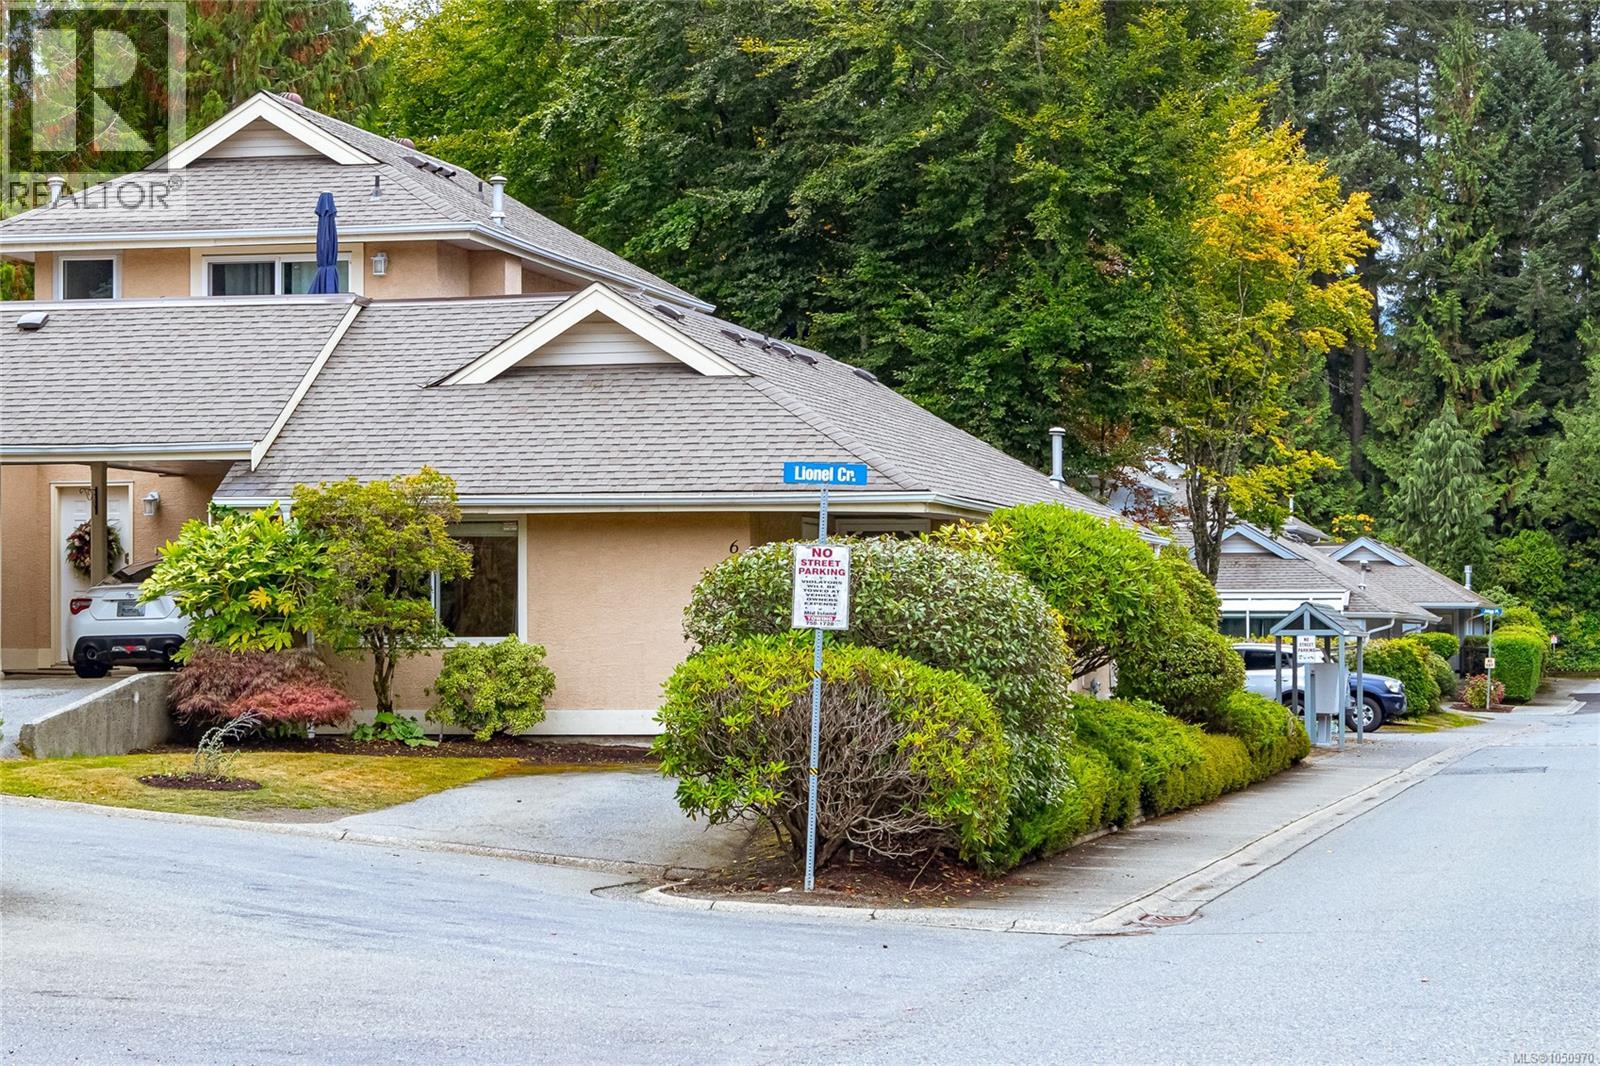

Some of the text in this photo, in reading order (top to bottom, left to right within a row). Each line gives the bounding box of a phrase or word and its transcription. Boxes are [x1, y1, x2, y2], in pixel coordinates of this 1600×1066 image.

[794, 465, 856, 482] Lionel Cr.
[729, 539, 739, 554] 6
[812, 548, 833, 558] NO
[800, 559, 841, 567] STREET
[798, 568, 846, 576] PARKING
